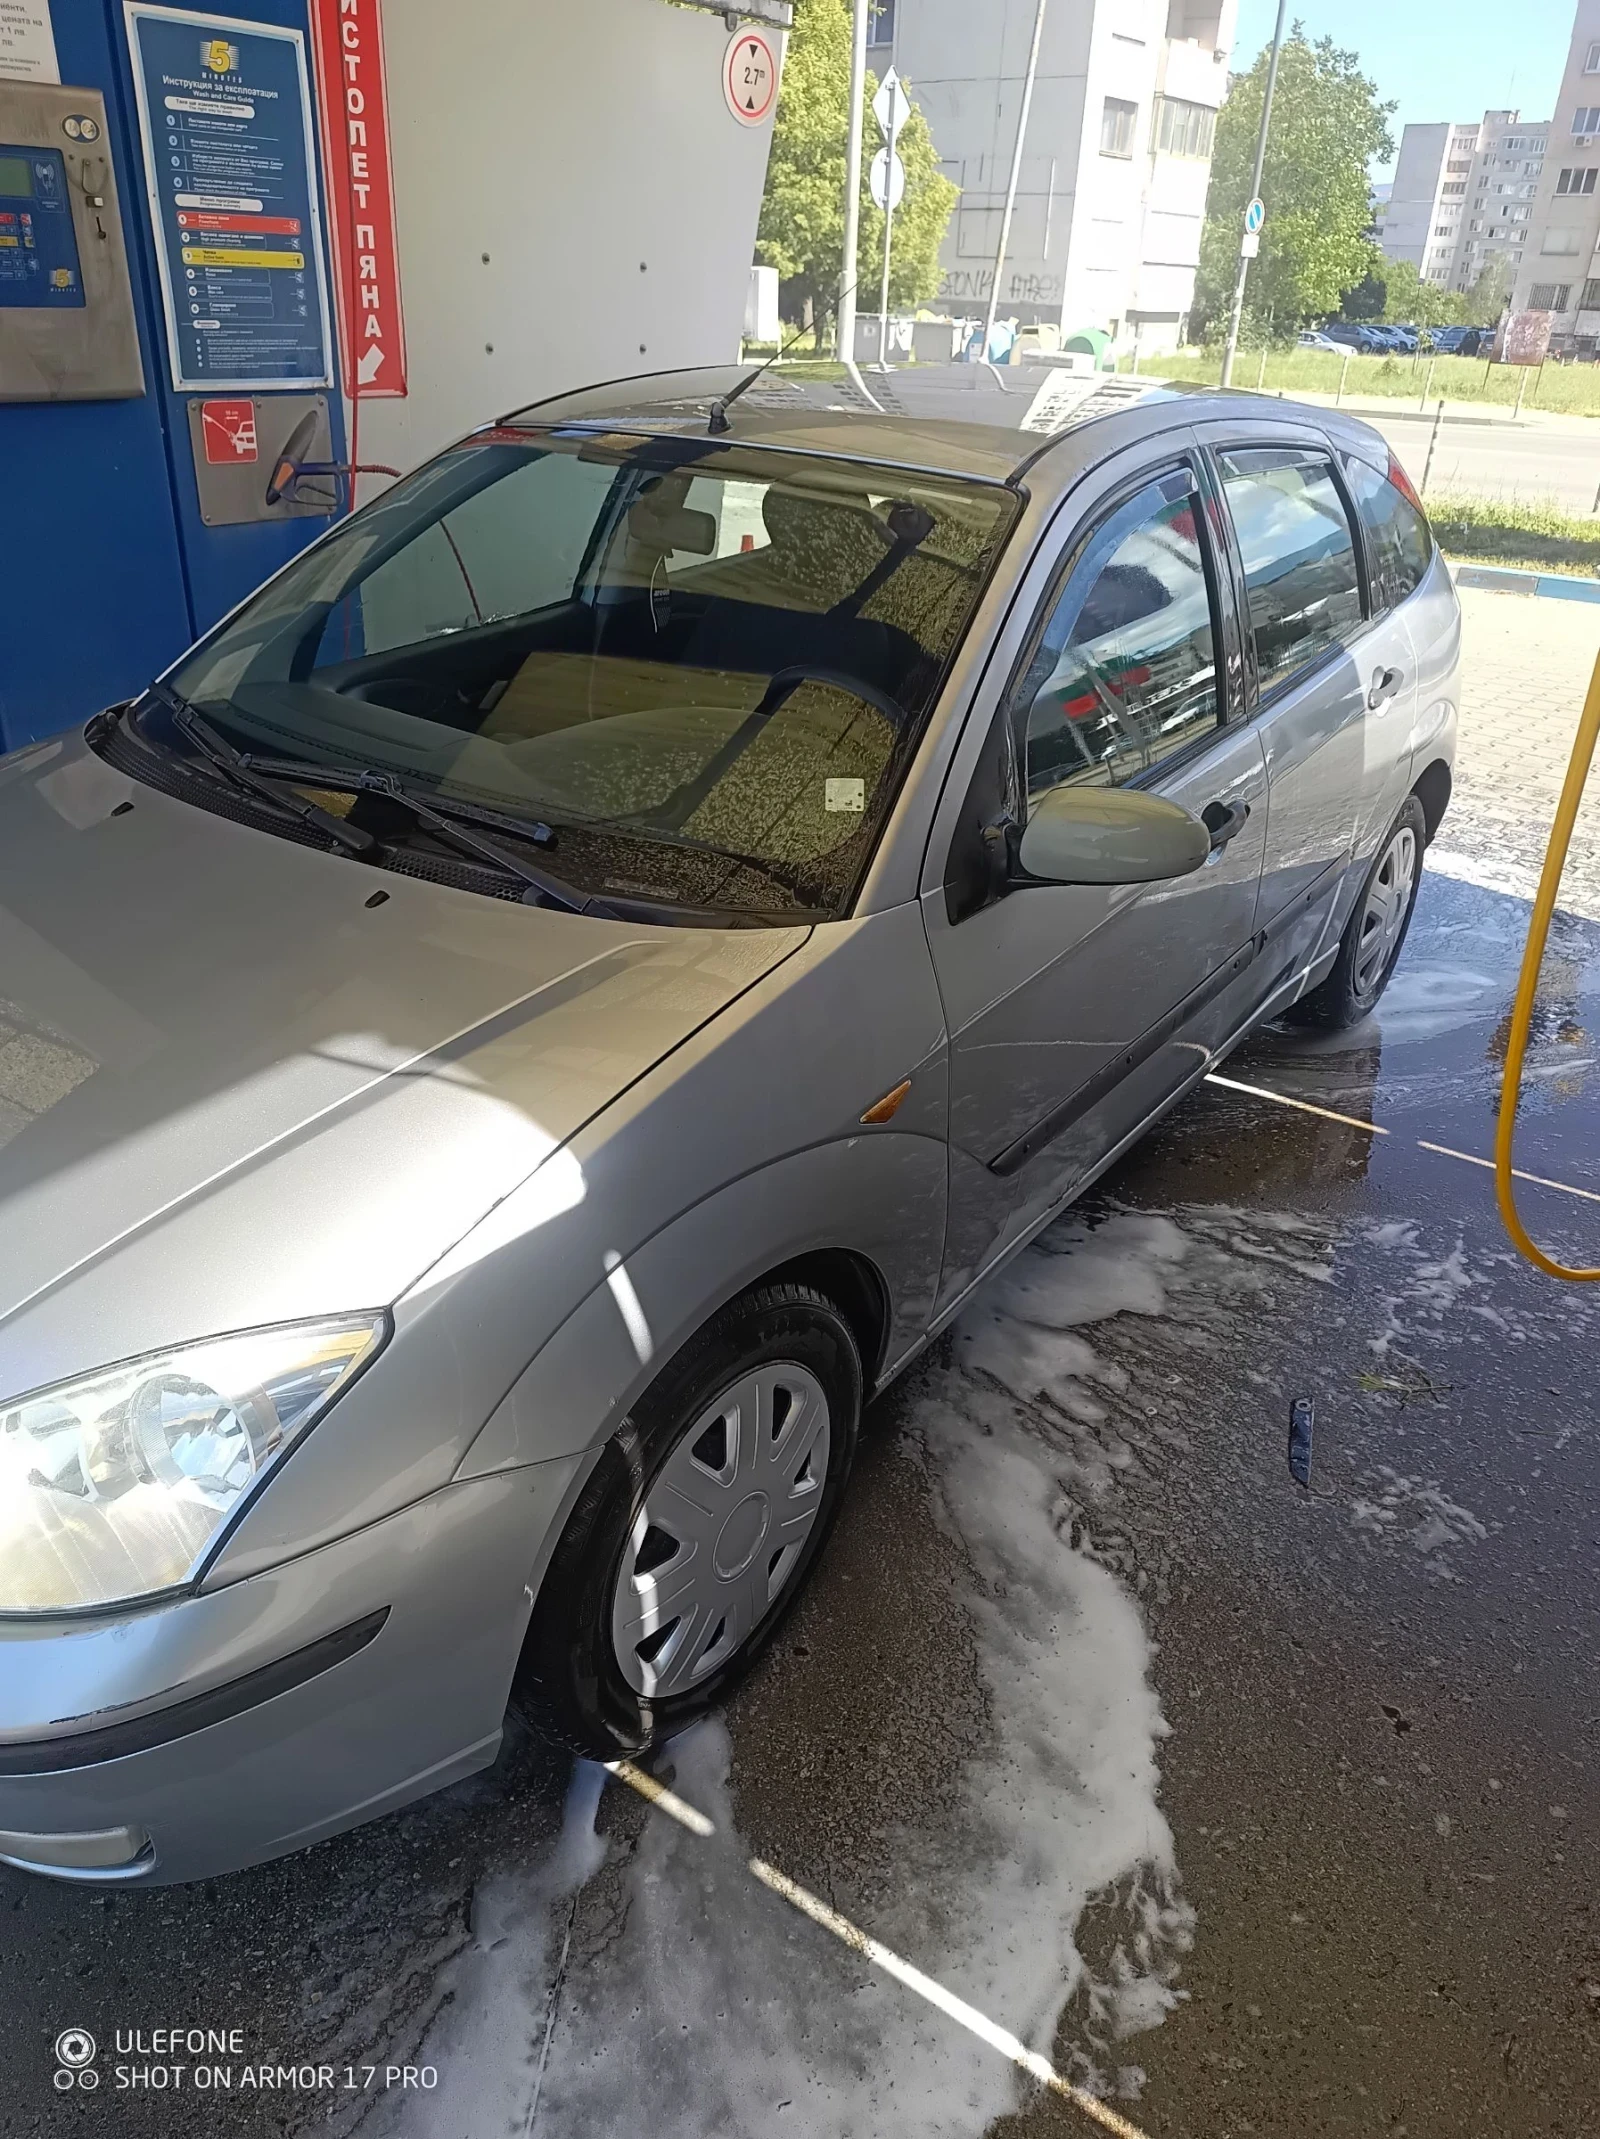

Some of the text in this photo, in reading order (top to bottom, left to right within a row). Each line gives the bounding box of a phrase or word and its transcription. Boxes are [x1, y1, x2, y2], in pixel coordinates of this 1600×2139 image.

[208, 40, 231, 73] 5
[162, 74, 279, 100] Инструкция за експлоатация
[201, 72, 243, 83] MINUTES
[193, 90, 255, 104] Wash and Care Guide
[55, 268, 70, 288] 5
[356, 224, 383, 338] ПЯНА
